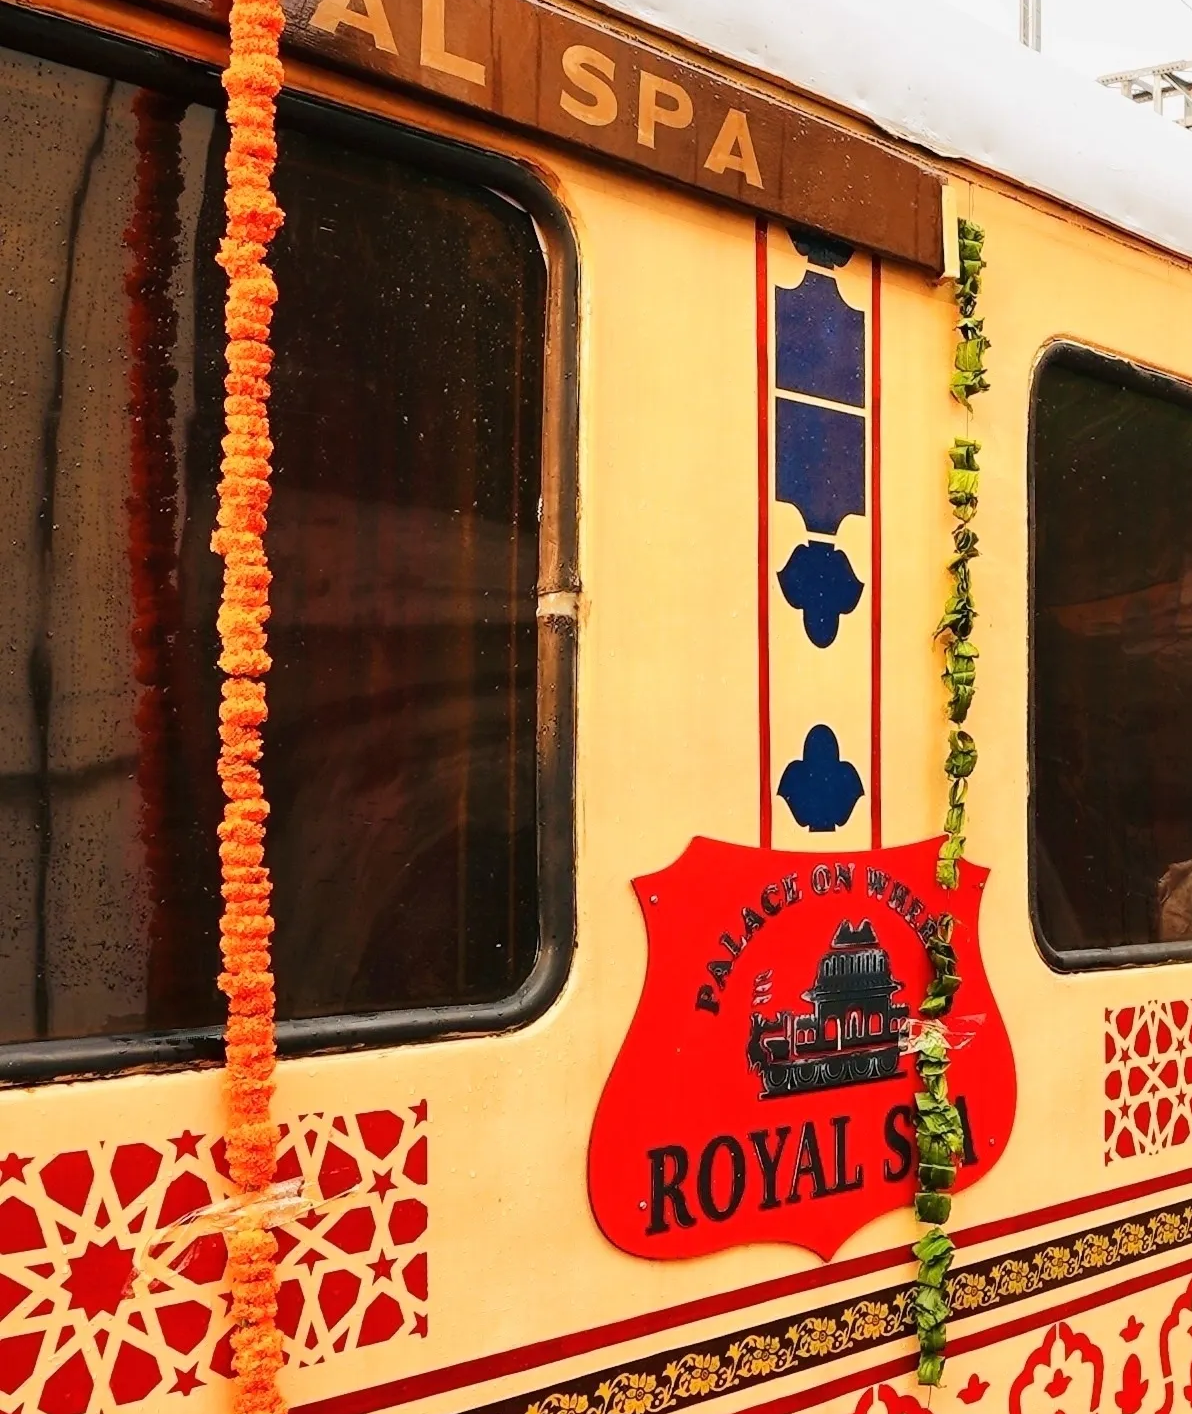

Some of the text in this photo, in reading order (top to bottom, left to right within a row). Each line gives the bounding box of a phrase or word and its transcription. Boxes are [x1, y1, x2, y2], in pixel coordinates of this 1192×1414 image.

[559, 44, 764, 190] SPA
[695, 872, 803, 1016] PALACE
[811, 862, 856, 895] ON
[644, 1095, 980, 1236] ROYAL SA
